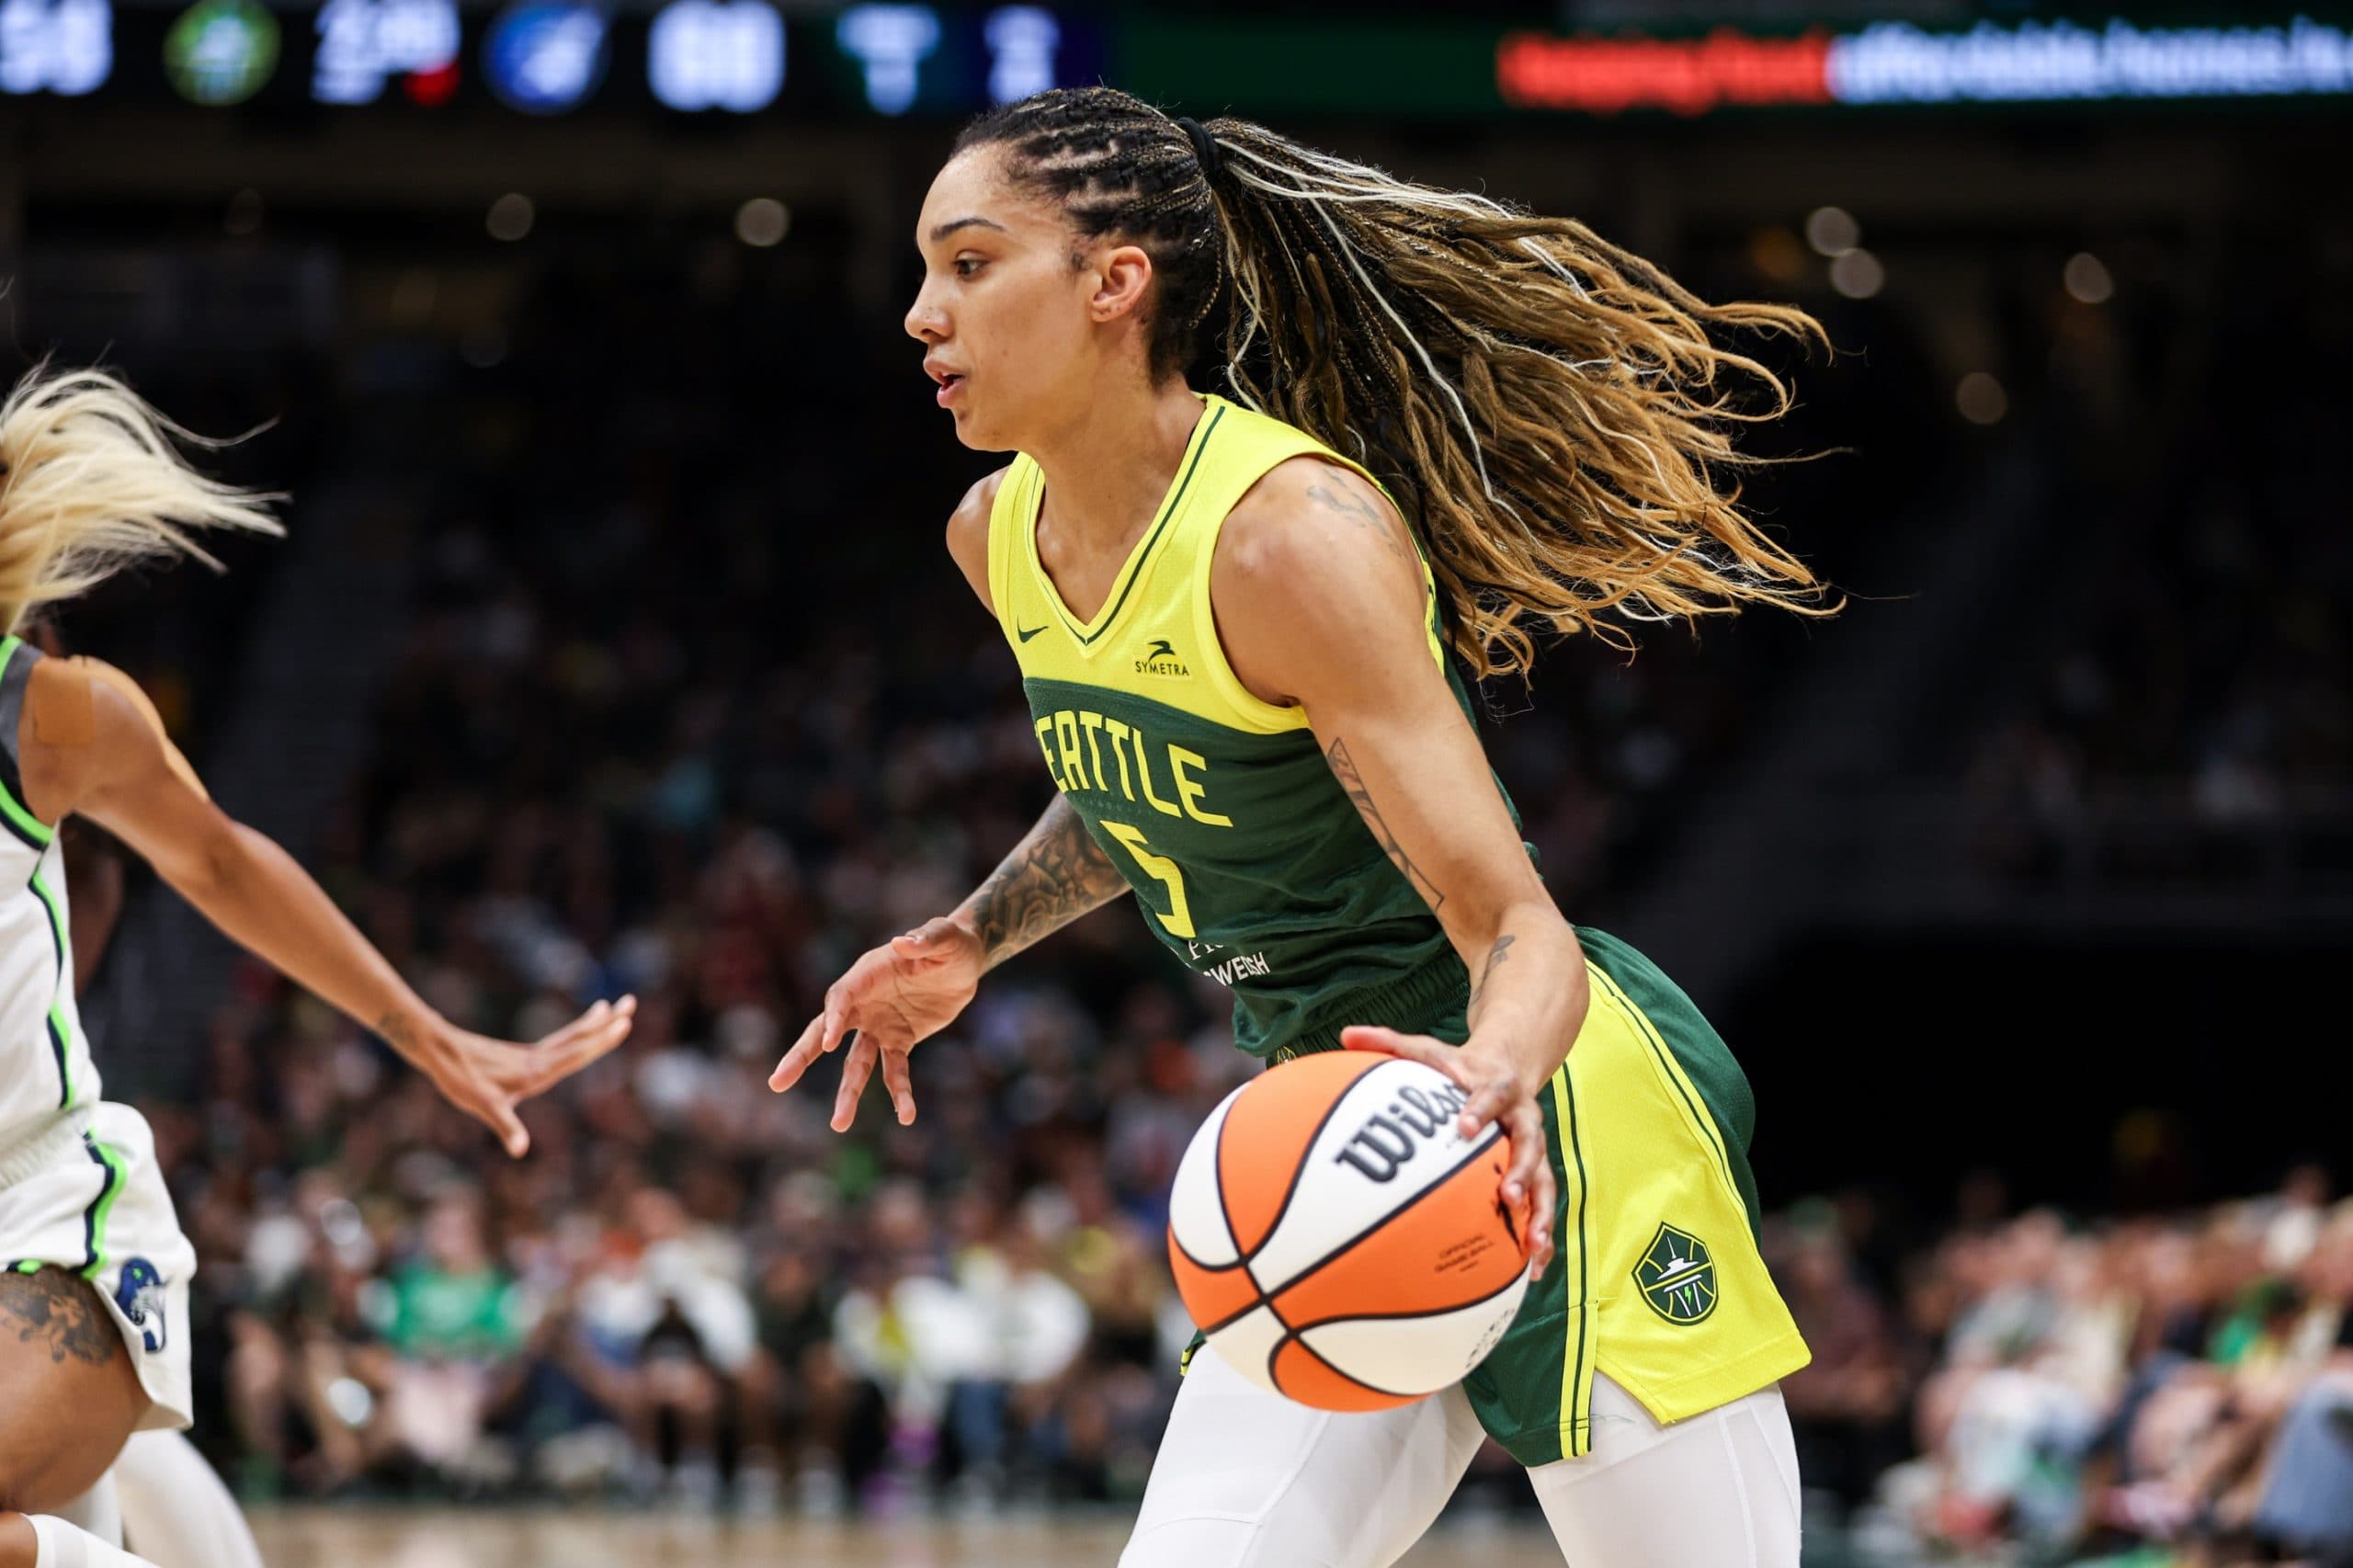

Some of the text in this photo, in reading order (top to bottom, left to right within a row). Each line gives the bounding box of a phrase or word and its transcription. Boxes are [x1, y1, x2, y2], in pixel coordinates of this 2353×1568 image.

[1135, 661, 1190, 676] SYMETRA
[1035, 710, 1233, 827] EATTLE
[1098, 819, 1196, 938] 5
[1335, 1083, 1470, 1184] Wilso
